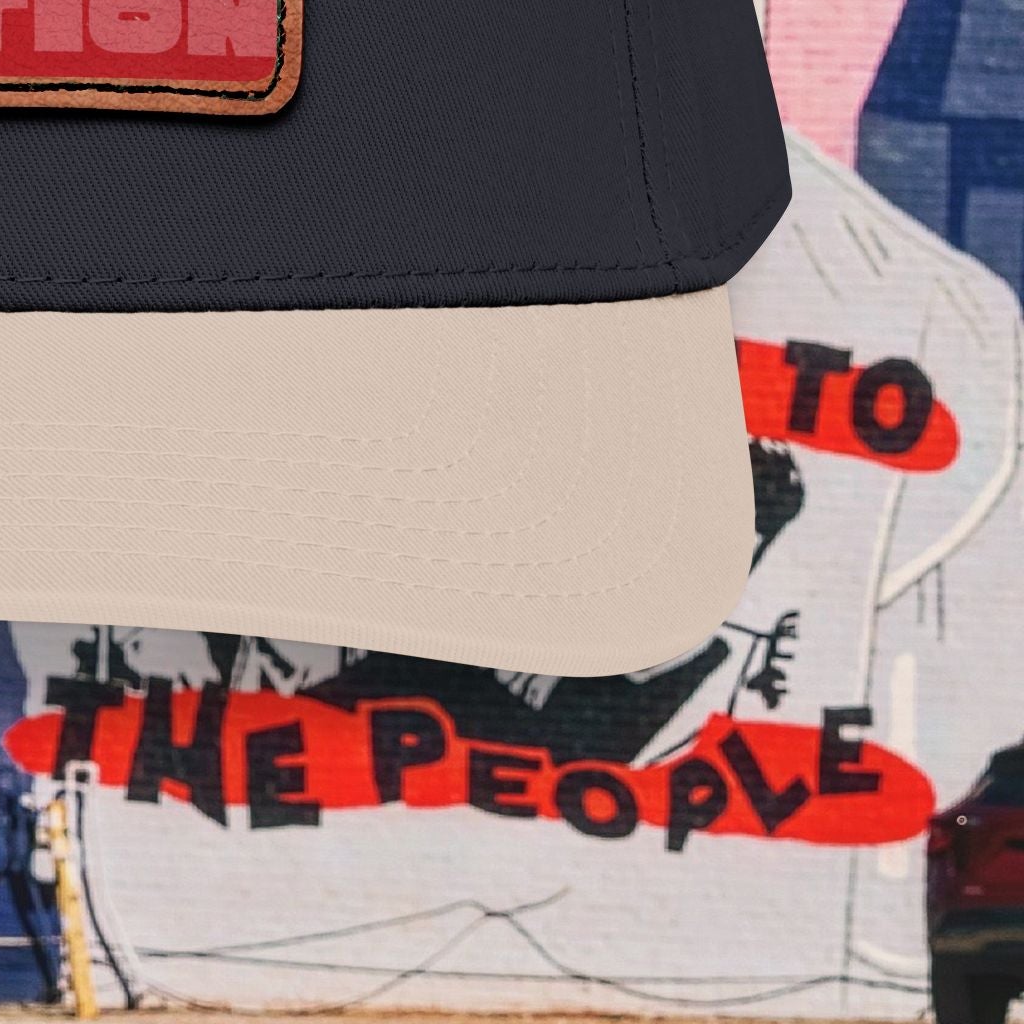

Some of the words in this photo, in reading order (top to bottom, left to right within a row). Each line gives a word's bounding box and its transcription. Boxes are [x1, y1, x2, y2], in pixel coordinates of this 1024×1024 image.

[784, 339, 933, 455] TO
[45, 675, 321, 828] THE
[371, 706, 881, 852] PEOPLE
